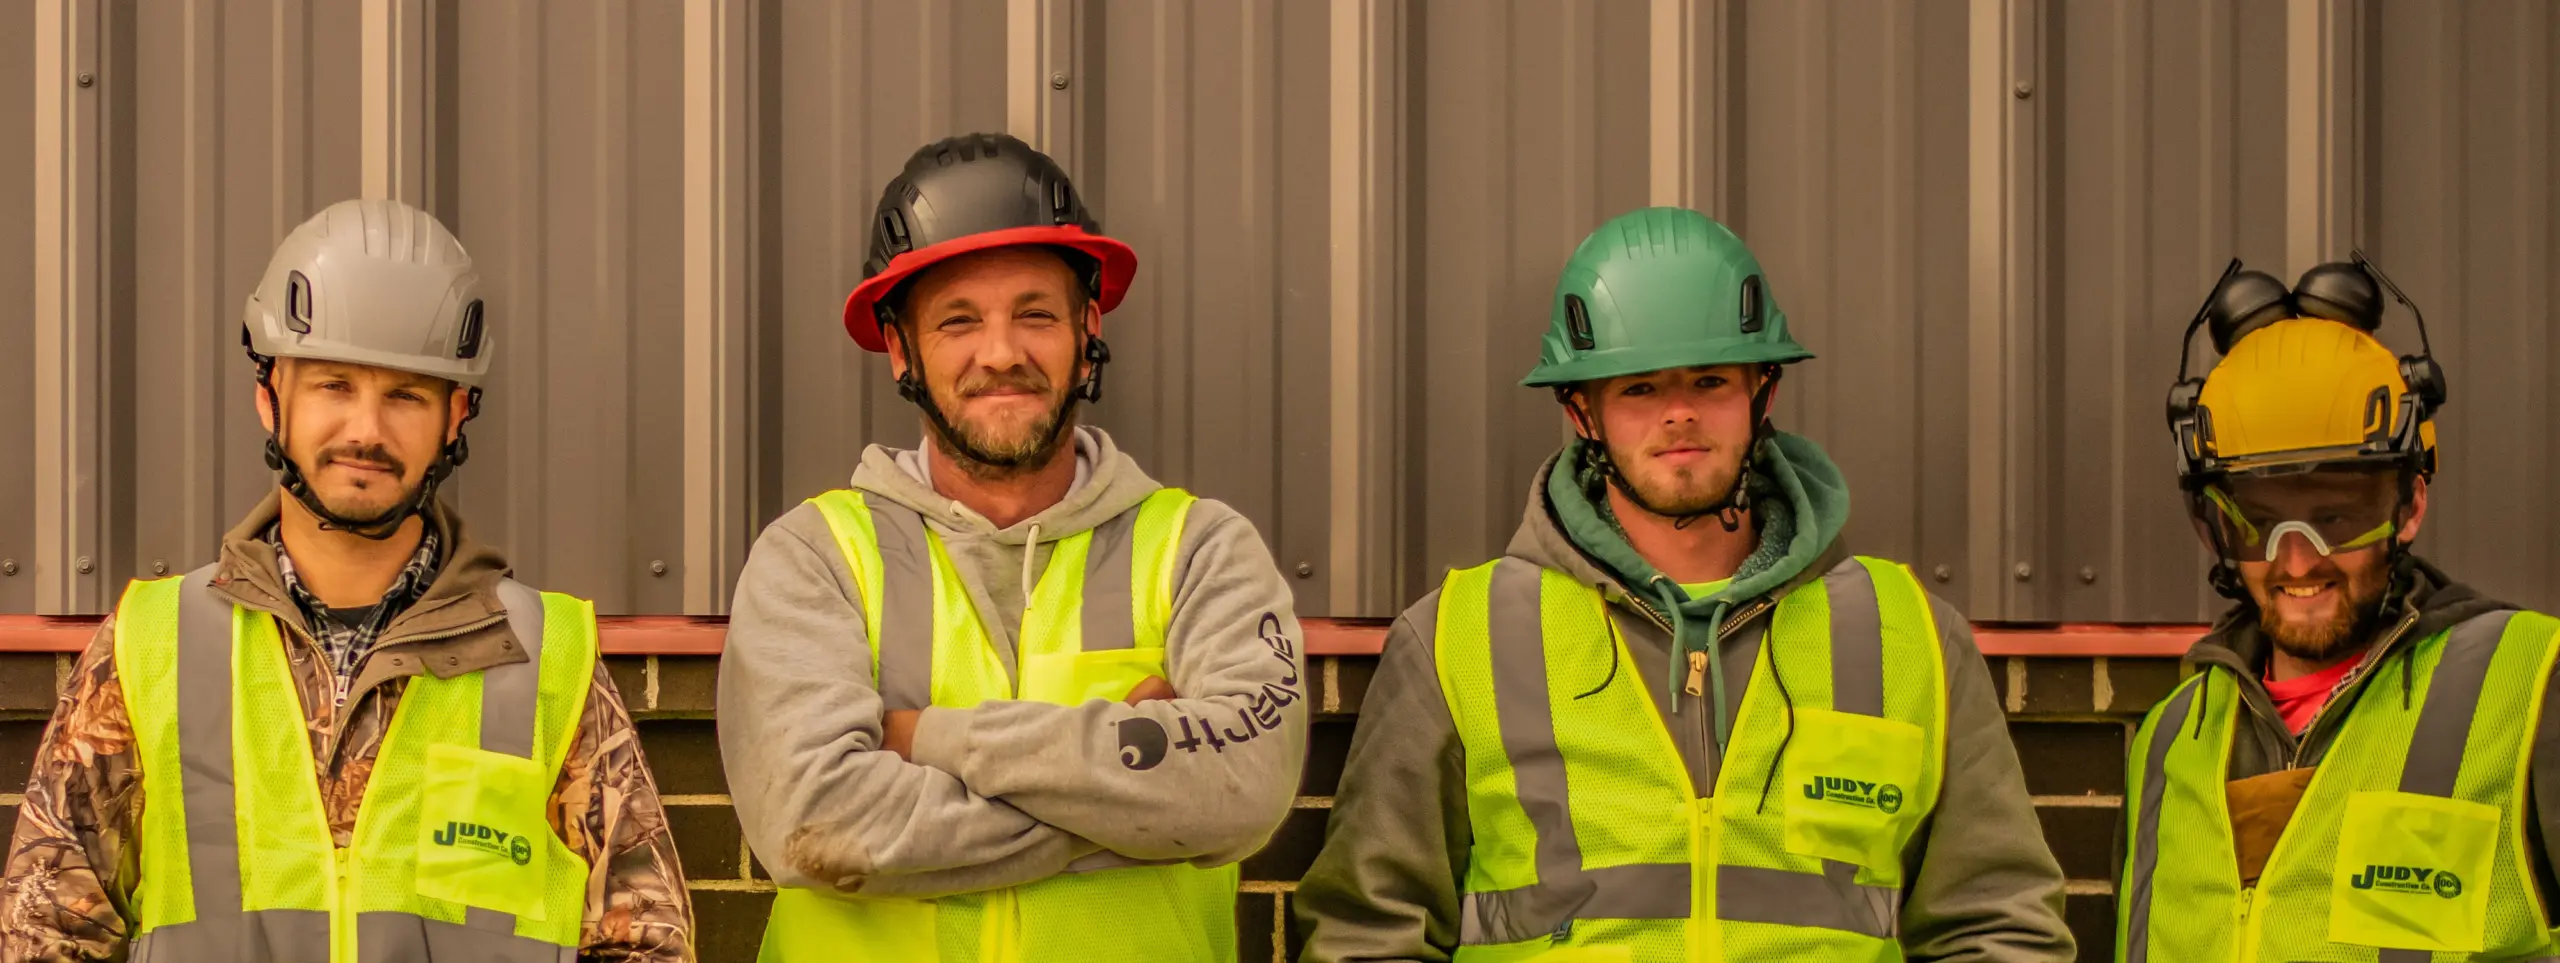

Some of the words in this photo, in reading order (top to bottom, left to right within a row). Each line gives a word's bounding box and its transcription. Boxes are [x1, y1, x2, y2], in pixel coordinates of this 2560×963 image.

[1803, 775, 1877, 800] JUDY
[1825, 790, 1864, 802] Construction
[433, 821, 508, 846] JUDY
[457, 836, 499, 849] Construction
[2351, 865, 2433, 889] JUDY
[2375, 880, 2419, 890] Construction
